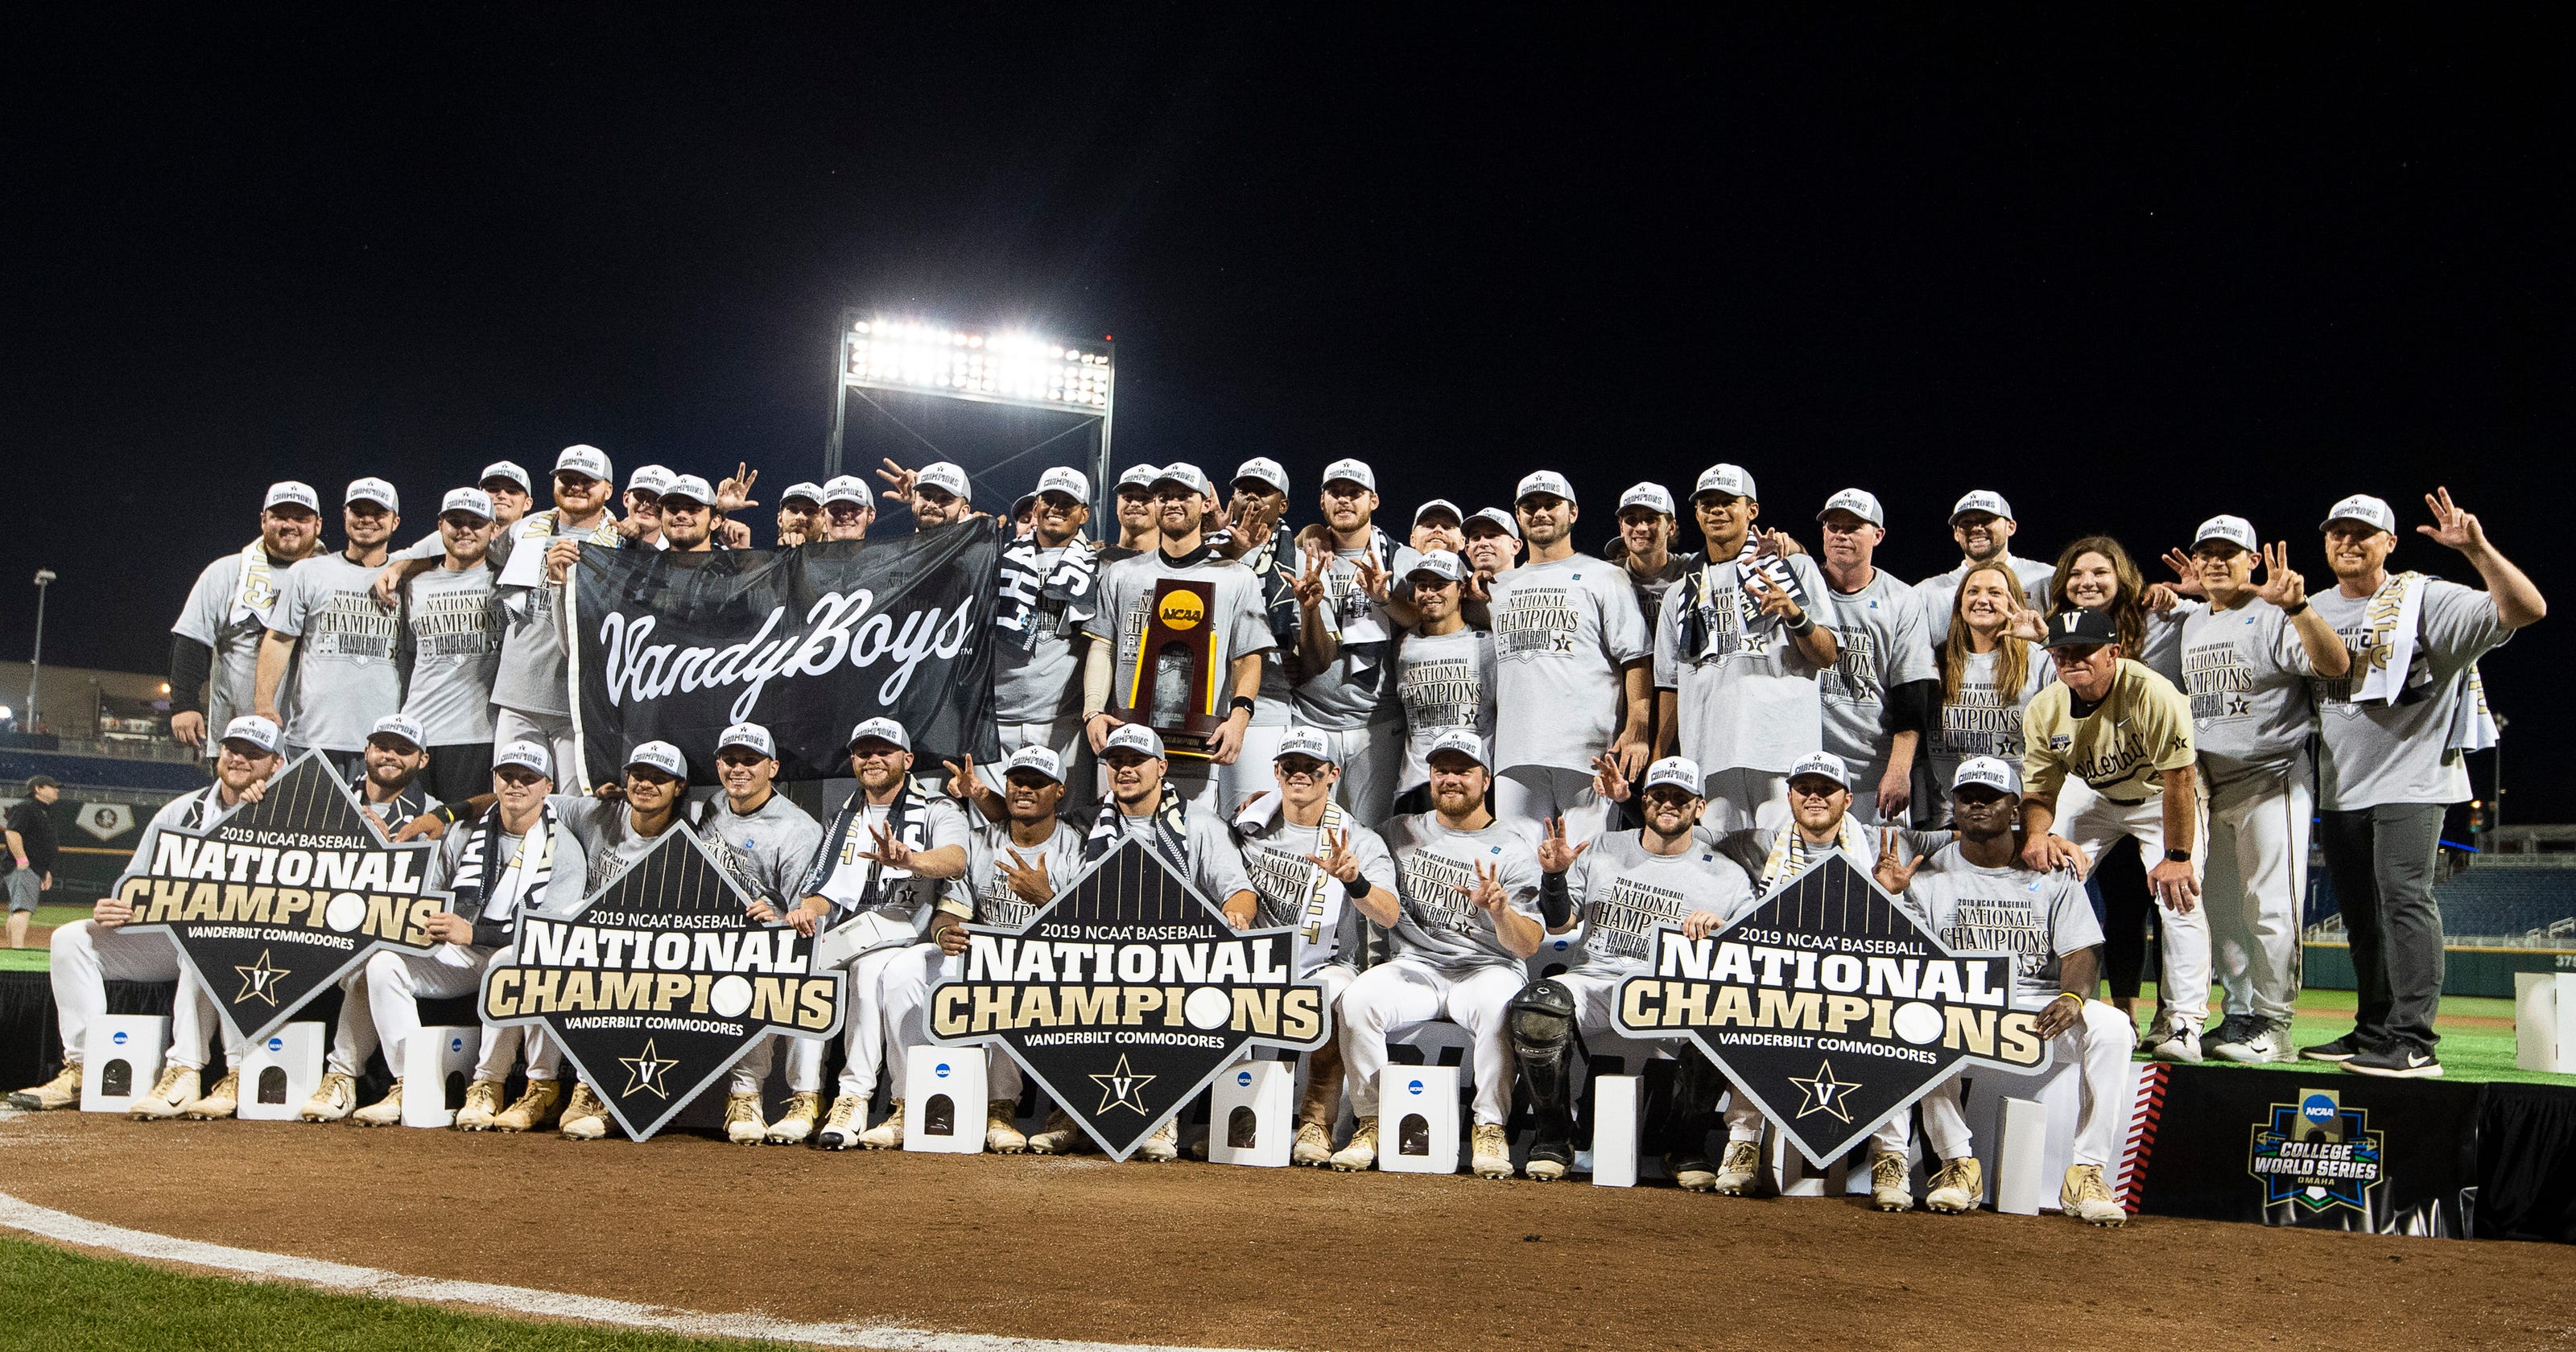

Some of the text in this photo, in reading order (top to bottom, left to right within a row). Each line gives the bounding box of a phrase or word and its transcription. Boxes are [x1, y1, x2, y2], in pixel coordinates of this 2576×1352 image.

[1507, 594, 1567, 611] NATIONAL
[1162, 608, 1203, 623] NCAA
[1496, 608, 1579, 636] CHAMPIONS
[2062, 611, 2082, 633] V
[434, 633, 483, 649] VANDERBILT
[1509, 630, 1551, 645] VANDERBILT
[1509, 642, 1550, 653] COMMODORES
[1439, 657, 1468, 666] BASEBALL
[1409, 666, 1470, 685] NATIONAL
[1417, 704, 1460, 721] VANDERBILT
[1942, 707, 2021, 734] AMPIONS
[1944, 731, 1993, 748] VANDERBILT
[2052, 735, 2070, 744] NASH
[220, 826, 254, 843] 2019
[299, 833, 366, 850] BASEBALL
[151, 832, 421, 893] NATIONAL
[1414, 847, 1473, 872] 2019 NCAA BASEBALL
[1409, 856, 1470, 889] NATIONAL
[1616, 876, 1684, 901] 2019 NCAA BASEBALL
[1610, 885, 1682, 918] NATIONAL
[1958, 898, 2031, 909] 2019 NCAA BASEBALL
[588, 909, 625, 926] 2019
[675, 914, 746, 930] BASEBALL
[1957, 908, 2035, 928] NATIONAL
[188, 925, 354, 950] VANDERBILT COMMODORES
[1040, 923, 1080, 938] 2019
[1136, 924, 1216, 939] BASEBALL
[1738, 926, 1781, 944] 2019
[1840, 938, 1927, 956] BASEBALL
[1940, 927, 2050, 955] CHAMPIONS
[520, 919, 808, 974] NATIONAL
[966, 934, 1287, 983] NATIONAL
[1658, 931, 2006, 1007] NATIONAL
[564, 1016, 743, 1037] VANDERBILT COMMODORES
[1024, 1031, 1224, 1049] VANDERBILT COMMODORES
[1719, 1032, 1937, 1065] VANDERBILT COMMODORES
[2306, 1107, 2334, 1117] NCAA
[2280, 1141, 2353, 1161] COLLEGE
[2254, 1156, 2378, 1180] WORLD SERIES
[2297, 1177, 2335, 1185] OMAHA
